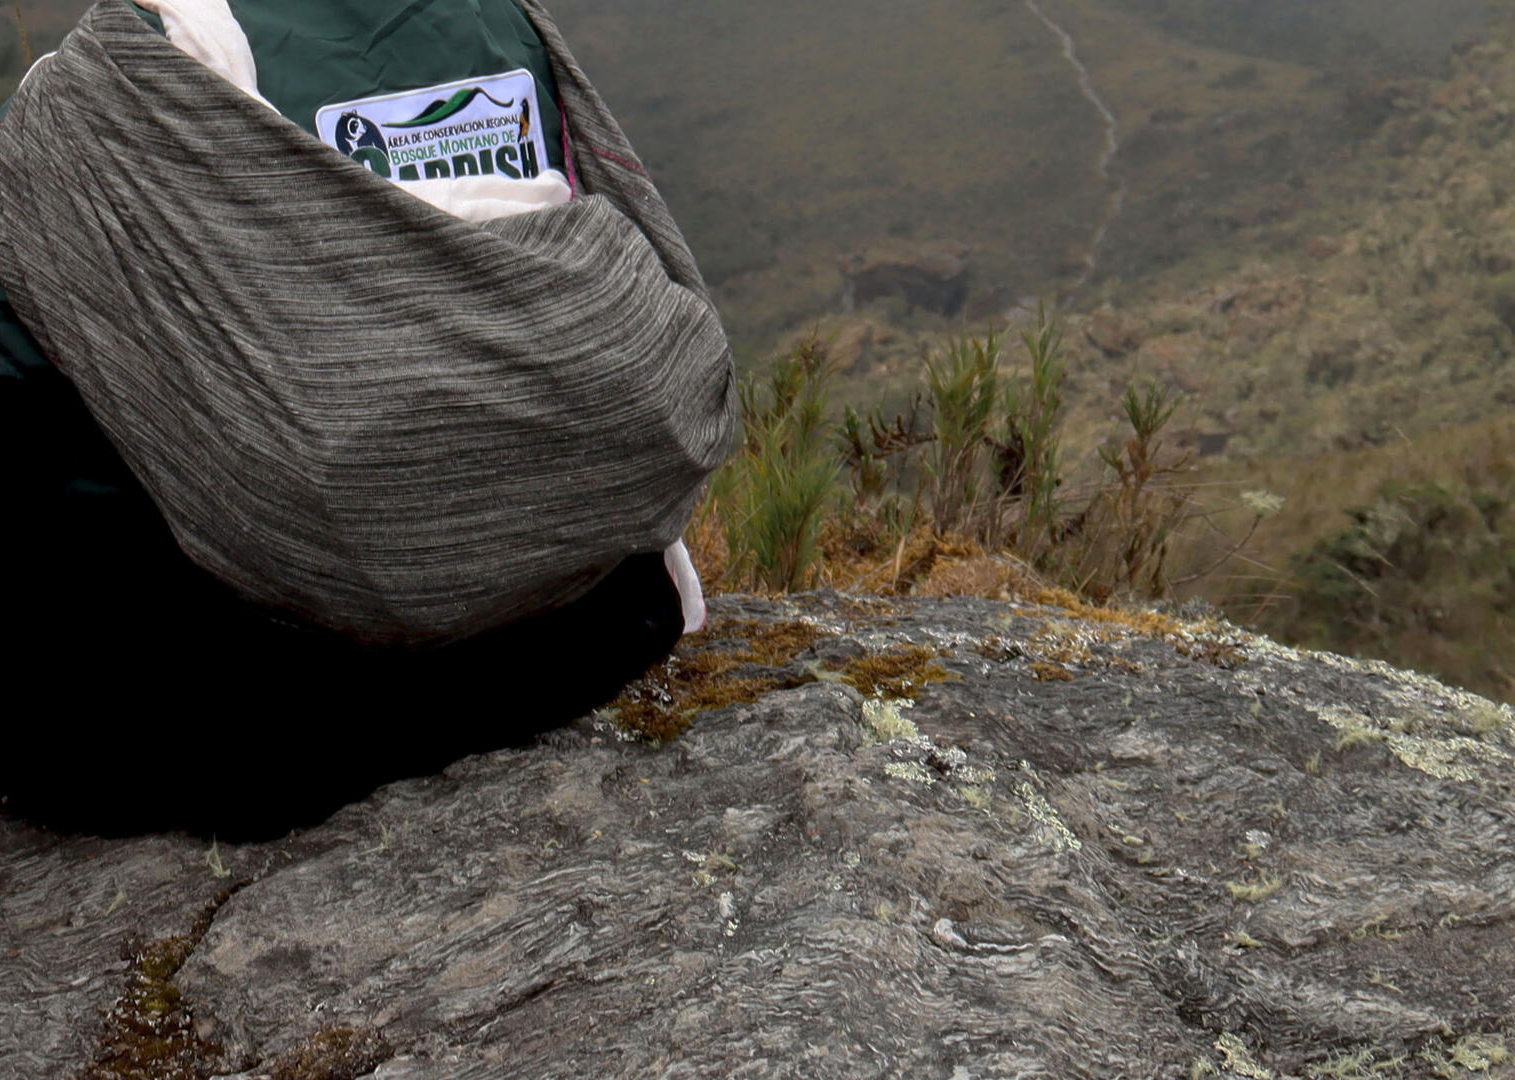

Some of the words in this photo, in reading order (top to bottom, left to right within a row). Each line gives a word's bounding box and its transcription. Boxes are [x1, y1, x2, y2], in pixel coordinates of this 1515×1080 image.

[411, 132, 422, 144] DE
[486, 114, 519, 129] REGIONAL
[502, 130, 515, 143] DE
